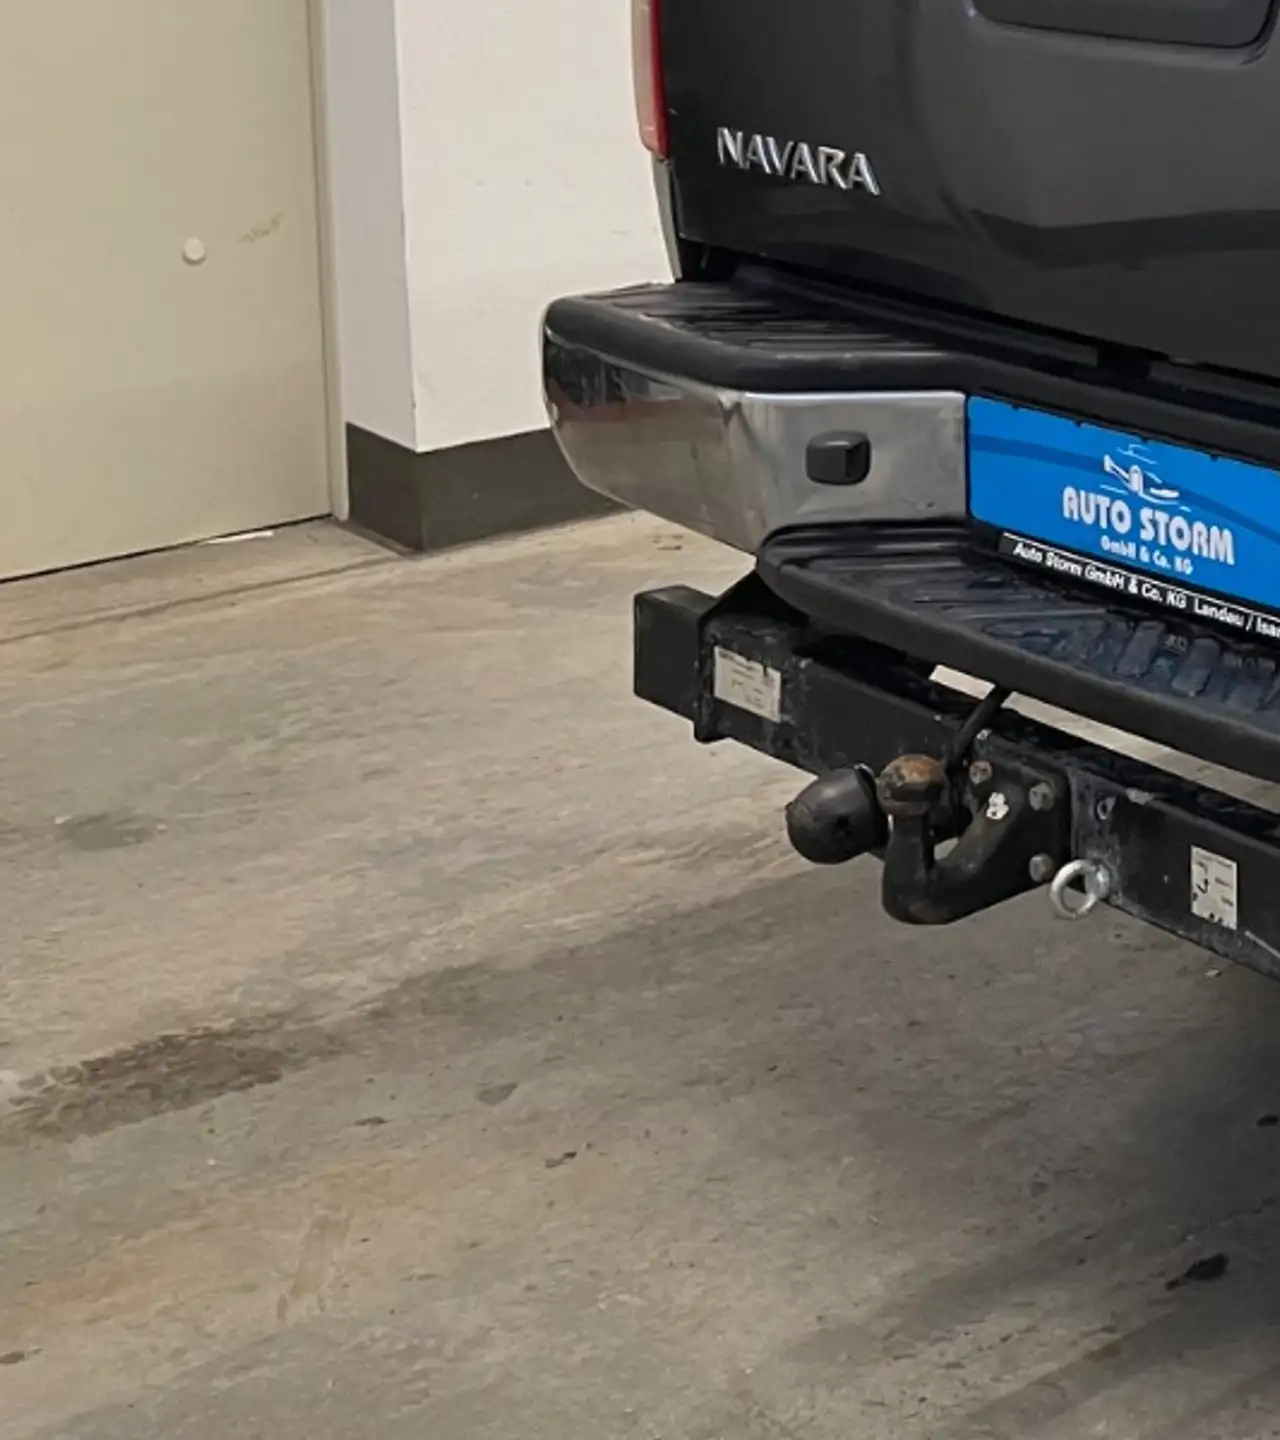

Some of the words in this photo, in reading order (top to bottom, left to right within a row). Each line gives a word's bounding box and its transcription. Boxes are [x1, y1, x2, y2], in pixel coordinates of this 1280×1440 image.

[717, 126, 882, 196] NAVARA
[1062, 485, 1132, 534] AUTO
[1139, 506, 1235, 566] STORM
[1101, 535, 1137, 560] GmbH
[1139, 544, 1150, 563] &
[1152, 548, 1173, 571] Co.
[1174, 555, 1194, 575] KG
[1013, 542, 1043, 563] Auto
[1046, 551, 1082, 578] Storm
[1085, 563, 1125, 592] GmbH
[1128, 579, 1139, 594] &
[1141, 583, 1163, 603] Co.
[1166, 591, 1188, 610] KG
[1194, 597, 1244, 627] Landau
[1245, 614, 1253, 631] /
